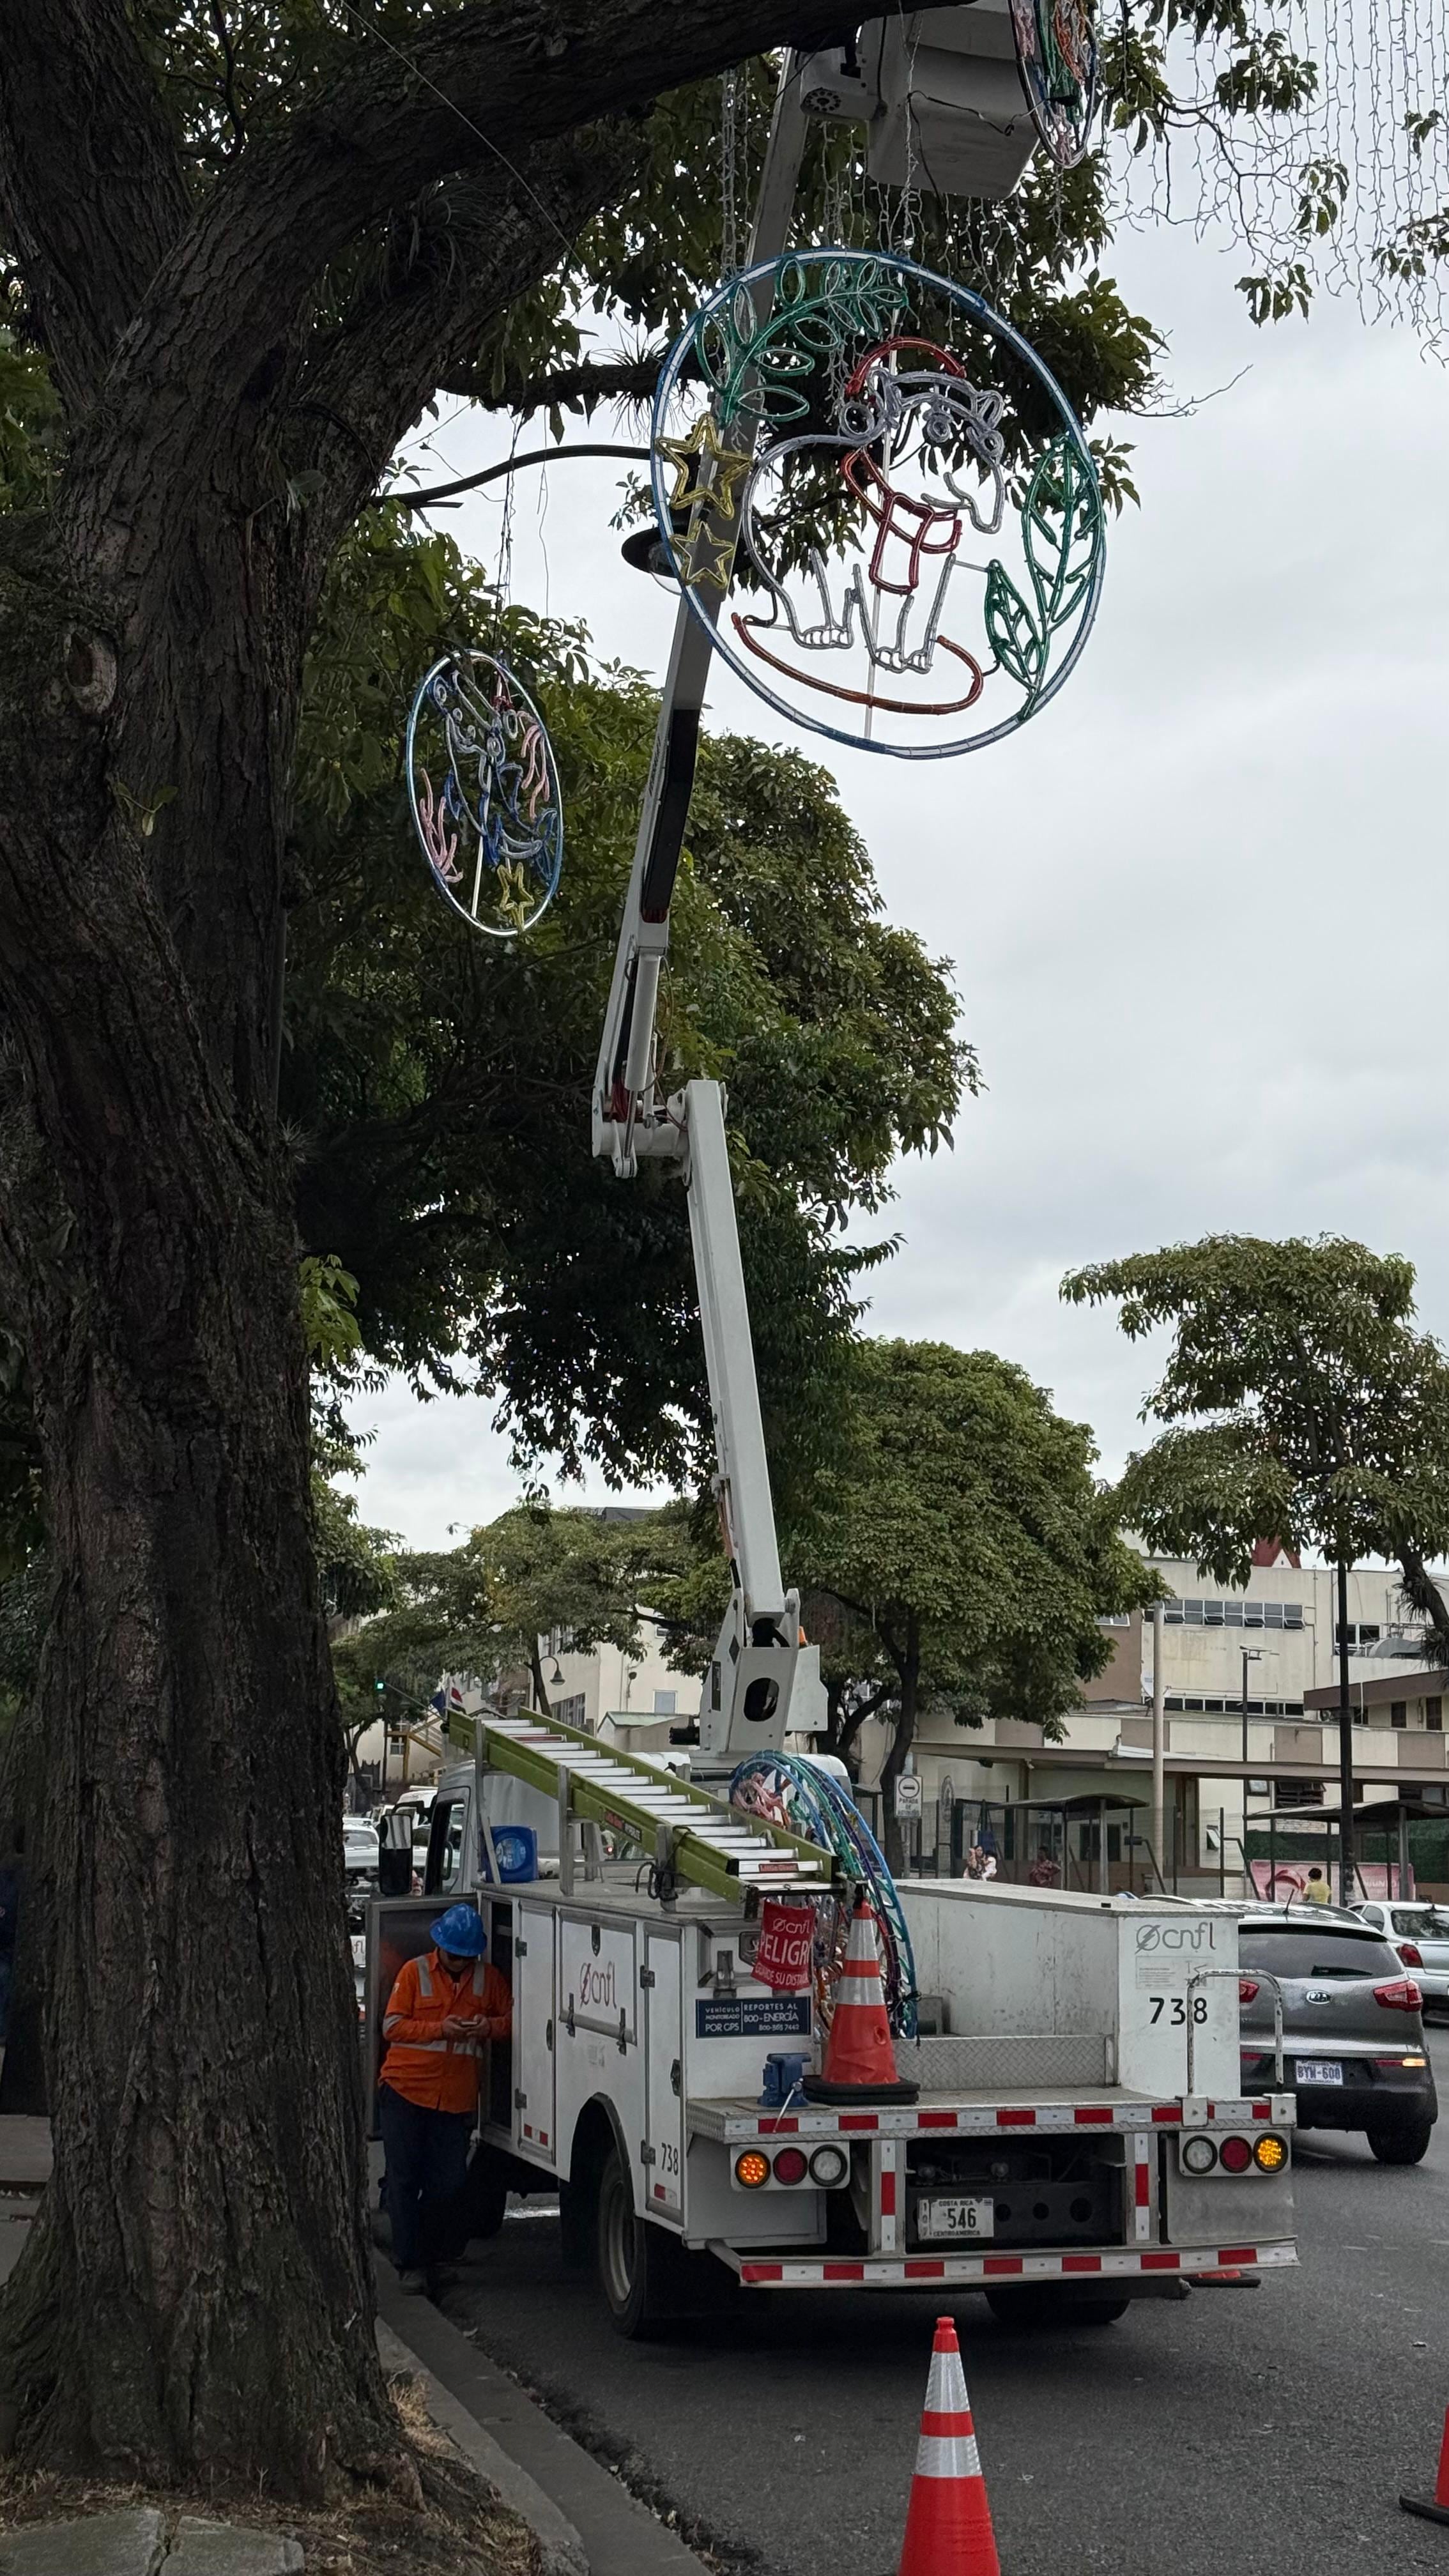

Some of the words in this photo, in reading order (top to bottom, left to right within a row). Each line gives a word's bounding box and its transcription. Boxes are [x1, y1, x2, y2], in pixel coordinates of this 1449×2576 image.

[1162, 1922, 1216, 1950] cnfl
[744, 2003, 784, 2011] REPORTES
[1149, 1997, 1208, 2025] 738
[705, 2023, 722, 2032] POR
[723, 2023, 740, 2031] GPS
[661, 2142, 678, 2176] 738
[947, 2207, 976, 2229] 546
